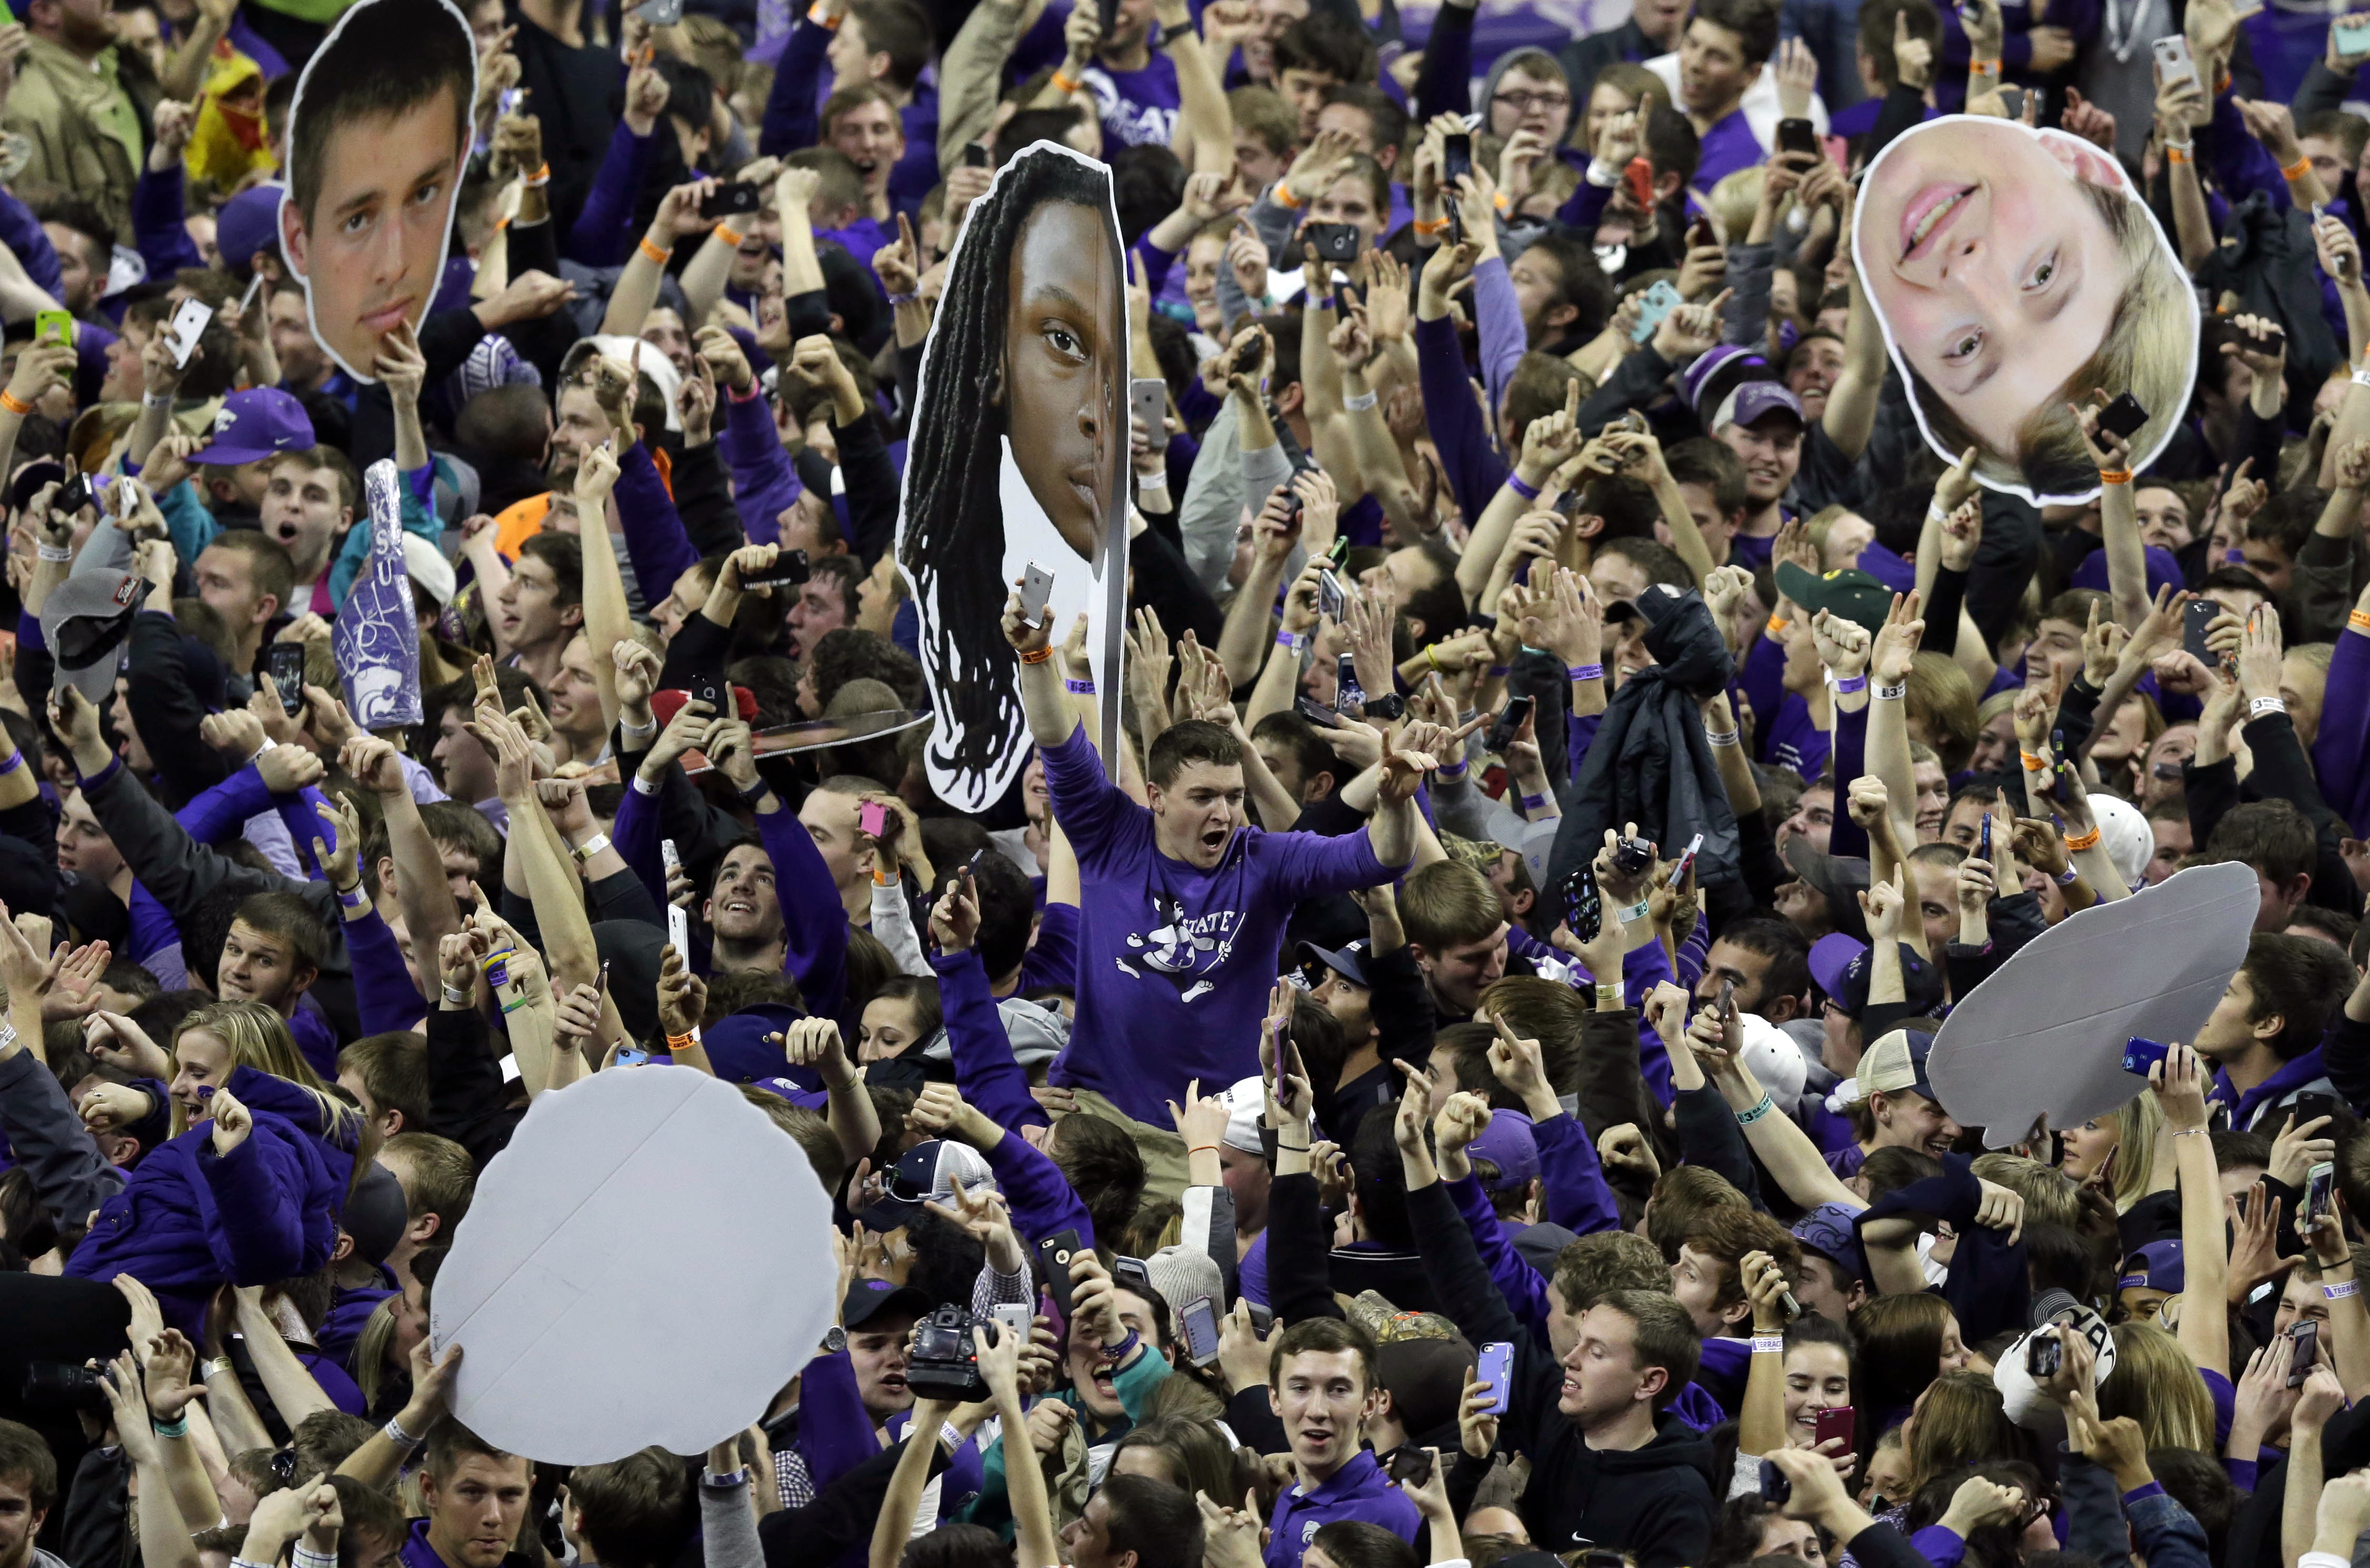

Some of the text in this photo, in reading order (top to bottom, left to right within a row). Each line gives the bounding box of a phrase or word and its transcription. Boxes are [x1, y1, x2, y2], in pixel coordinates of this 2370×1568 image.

[1889, 687, 1898, 697] 3
[2254, 699, 2263, 709] 3
[646, 785, 654, 793] 3
[1182, 910, 1236, 933] STATE
[1744, 1112, 1754, 1122] 3
